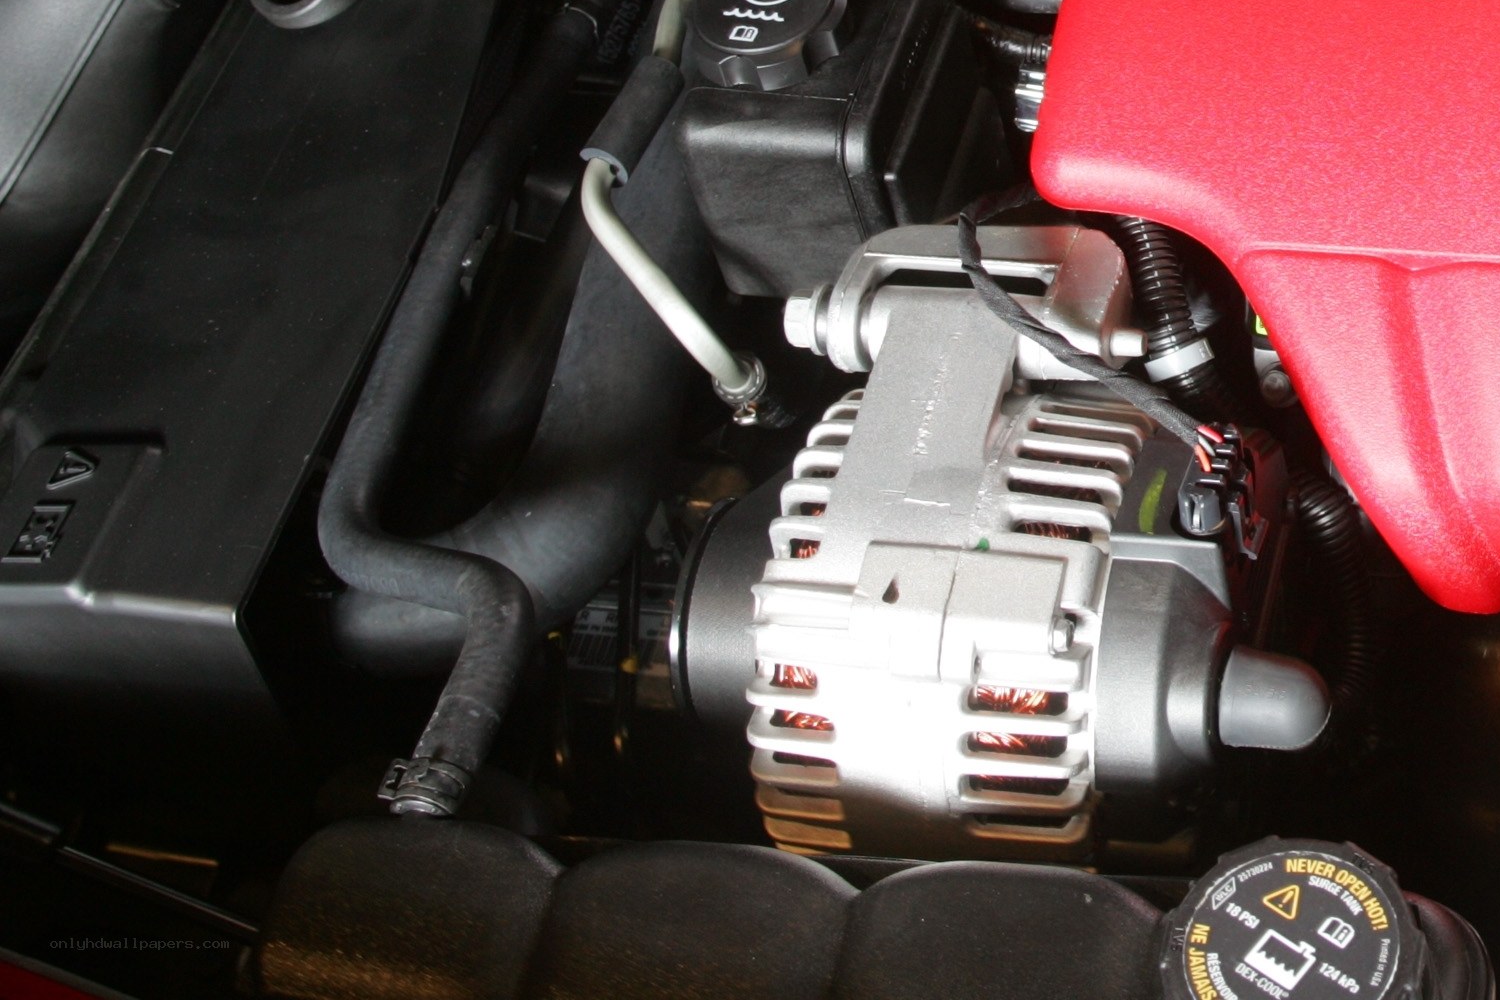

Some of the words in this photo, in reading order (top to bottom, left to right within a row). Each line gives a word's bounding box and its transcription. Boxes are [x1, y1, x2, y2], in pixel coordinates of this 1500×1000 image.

[1286, 859, 1336, 878] NEVER
[1335, 869, 1372, 901] OPEN
[1363, 897, 1389, 931] HOT!
[1308, 875, 1342, 896] SURGE
[1340, 890, 1363, 916] TANK
[1190, 923, 1210, 944] NE
[1226, 902, 1242, 917] 18
[1239, 910, 1260, 929] PSI
[1188, 947, 1217, 1000] JAMAIS
[1319, 962, 1341, 981] 124
[1338, 974, 1360, 994] kPa
